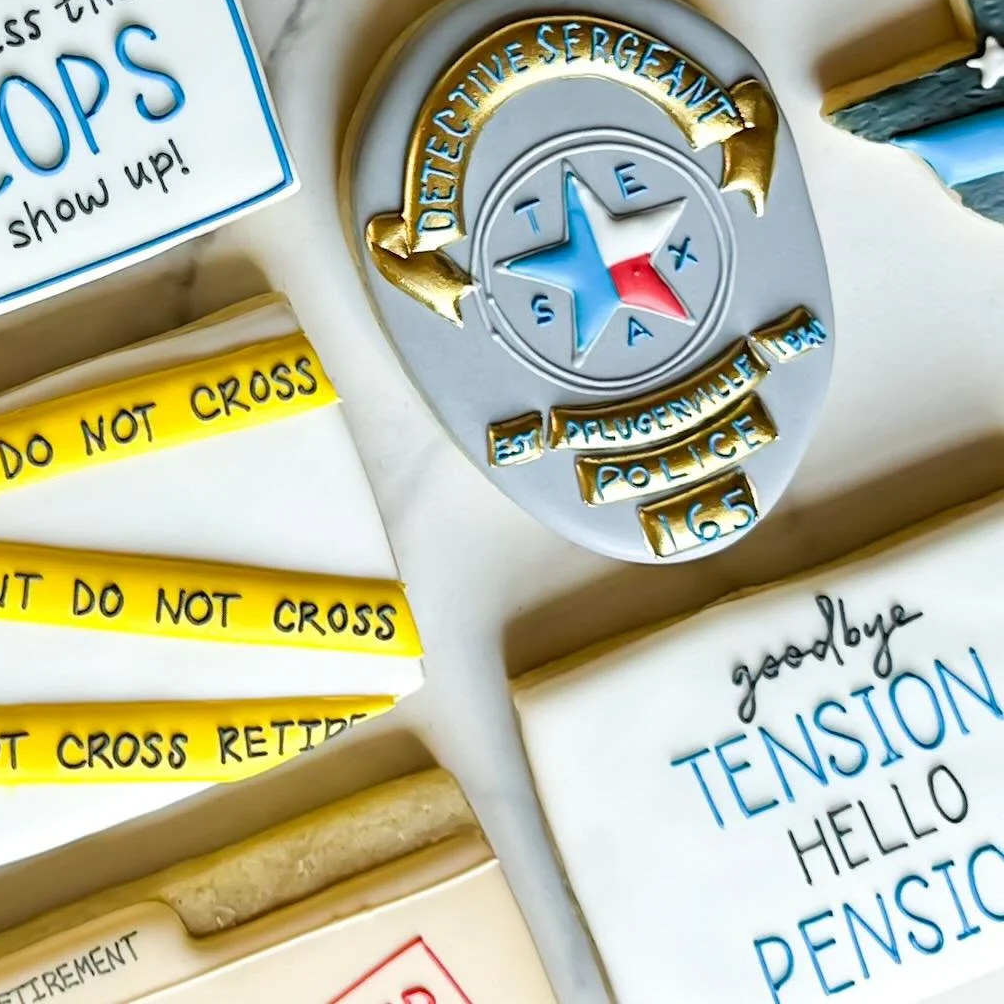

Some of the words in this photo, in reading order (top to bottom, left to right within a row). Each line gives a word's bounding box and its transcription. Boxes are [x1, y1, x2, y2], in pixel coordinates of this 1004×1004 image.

[416, 42, 526, 237] DETECTIVE
[537, 23, 738, 128] SERGEANT
[8, 180, 109, 250] show
[125, 139, 191, 193] up!
[81, 402, 157, 457] NOT
[189, 355, 319, 421] CROSS
[495, 429, 538, 461] EST
[596, 415, 762, 500] POLICE
[657, 489, 757, 553] 165
[73, 578, 125, 618] DO
[155, 588, 242, 628] NOT
[273, 599, 396, 641] CROSS
[731, 594, 923, 723] goodbye
[56, 731, 188, 772] CROSS
[669, 645, 1004, 830] TENSION
[787, 763, 969, 886] HELLO
